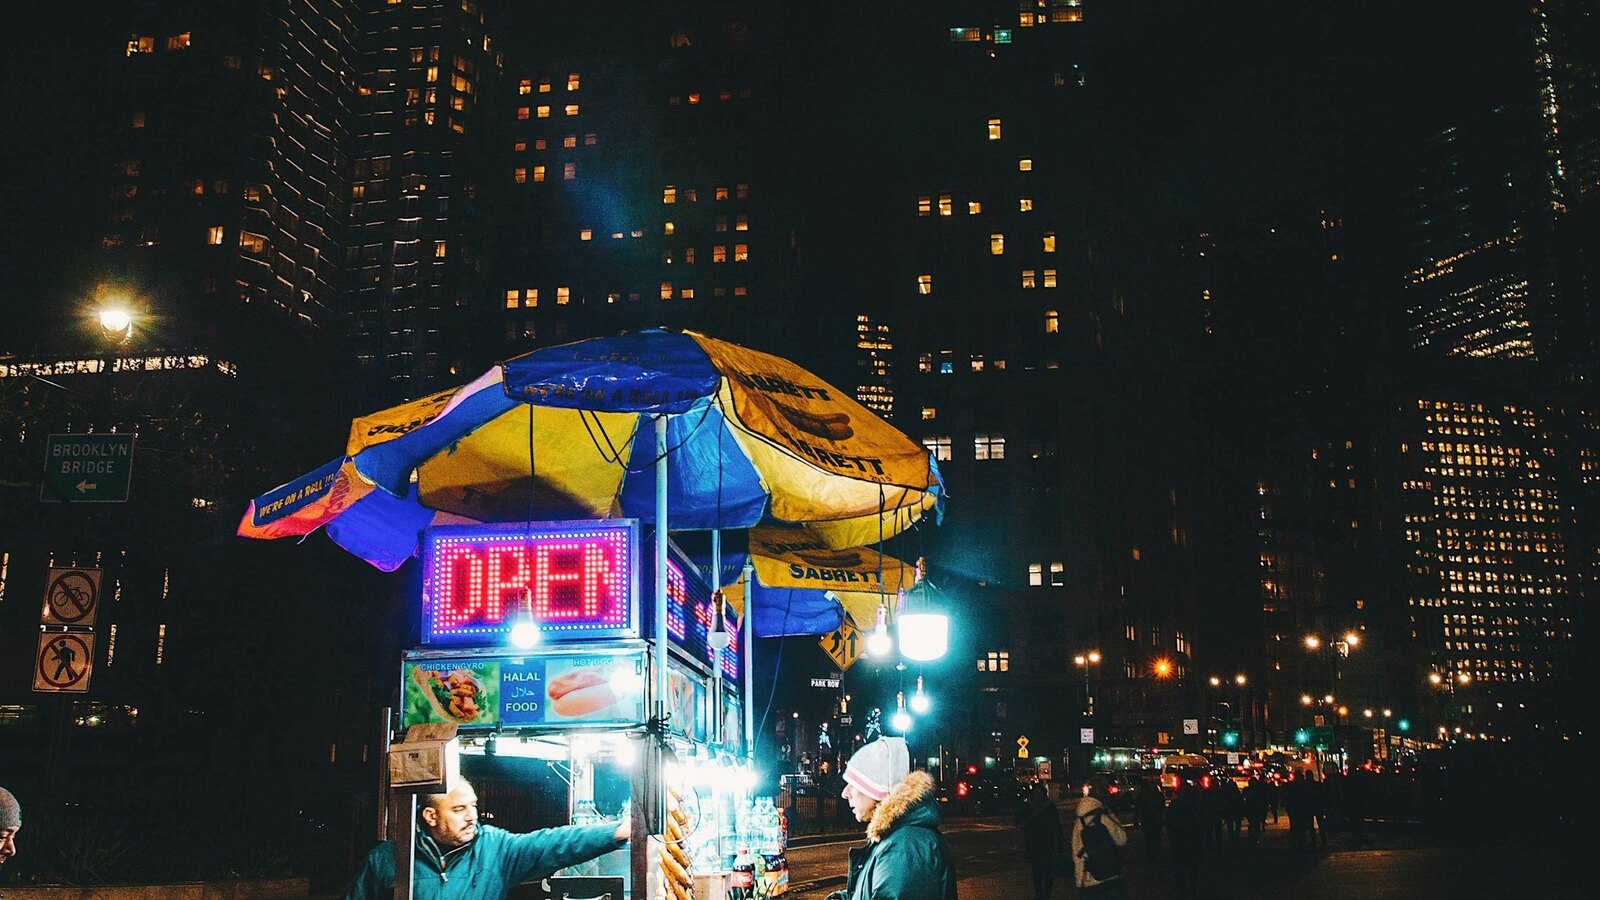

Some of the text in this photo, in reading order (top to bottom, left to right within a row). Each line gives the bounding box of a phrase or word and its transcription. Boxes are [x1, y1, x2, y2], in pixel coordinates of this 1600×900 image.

[53, 443, 128, 456] BROOKLYN
[61, 461, 115, 474] BRIDGE
[284, 492, 297, 506] ON
[297, 489, 303, 500] A
[305, 479, 323, 497] ROLL
[420, 662, 485, 671] CHICKEN GYRO
[573, 657, 592, 667] HOT
[503, 672, 541, 682] HALAL
[811, 679, 840, 688] PARK ROW
[511, 685, 535, 698] حلال
[505, 702, 538, 713] FOOD
